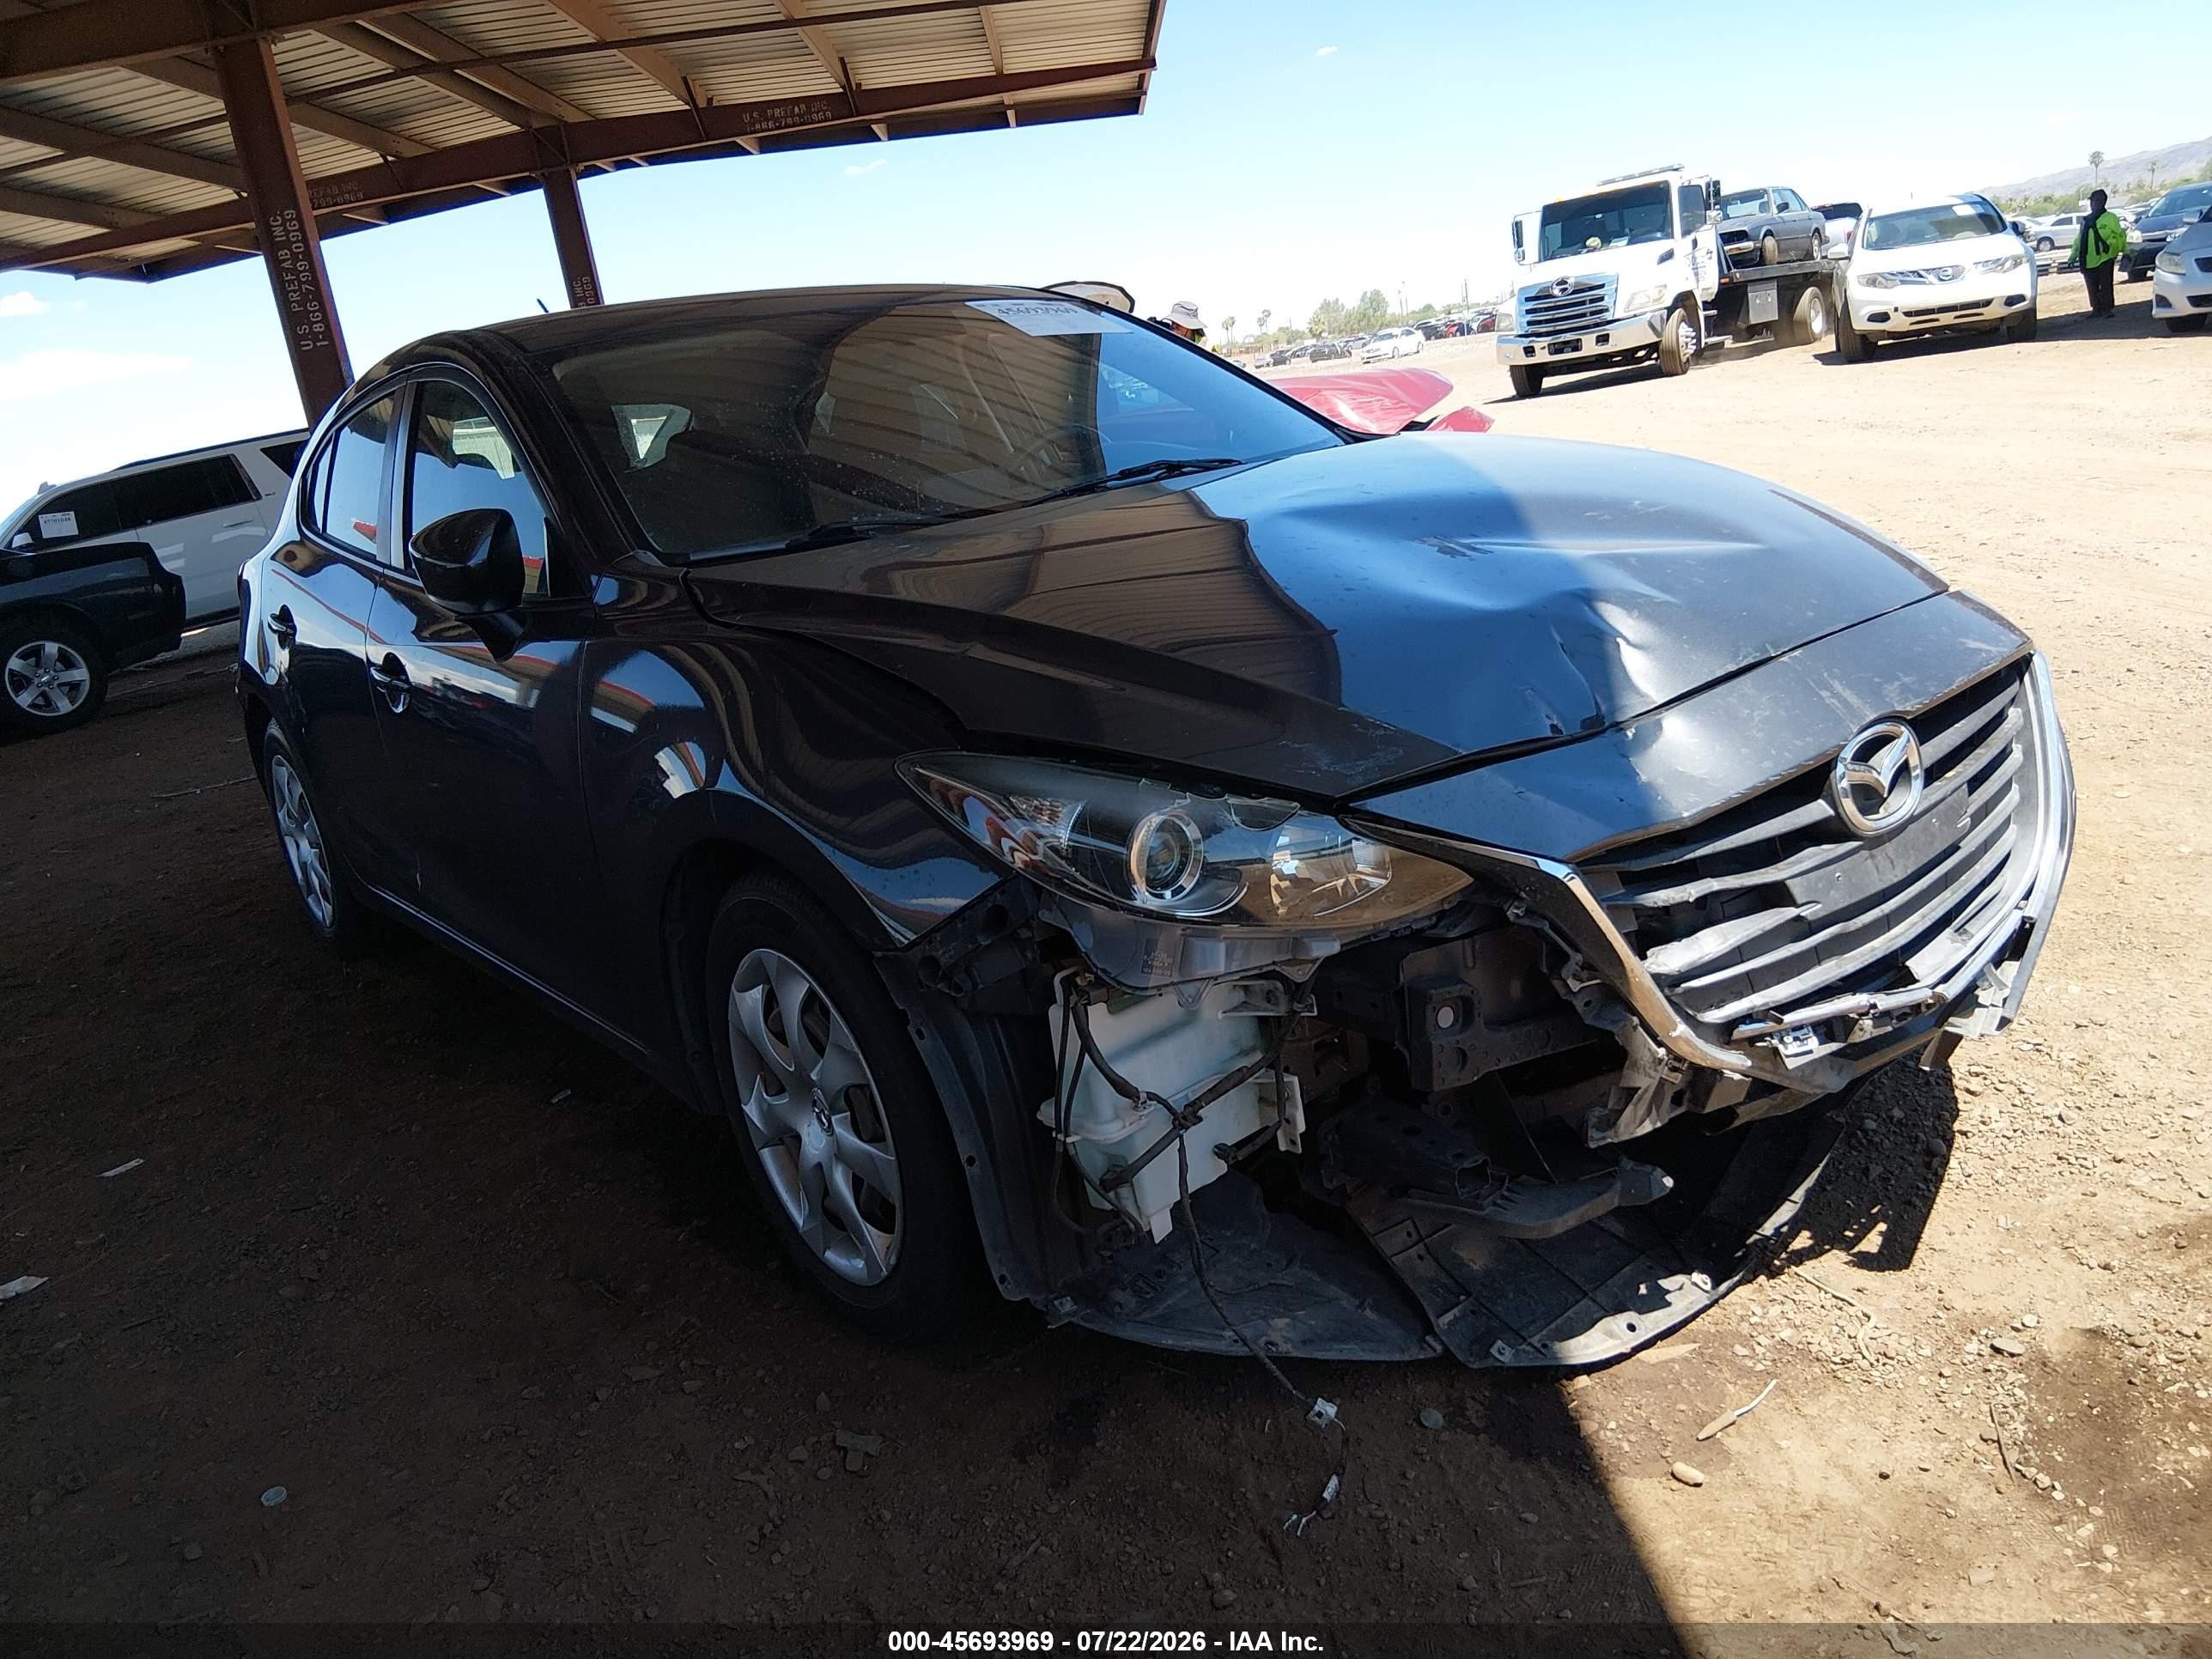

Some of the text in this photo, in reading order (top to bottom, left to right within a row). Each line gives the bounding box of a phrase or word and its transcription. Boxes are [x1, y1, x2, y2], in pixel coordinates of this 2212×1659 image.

[743, 110, 763, 123] U.S.
[811, 100, 831, 112] INC.
[270, 210, 314, 350] U.S. PREFAB INC.
[284, 210, 330, 346] 1-866-799-0969
[582, 276, 595, 304] 0969
